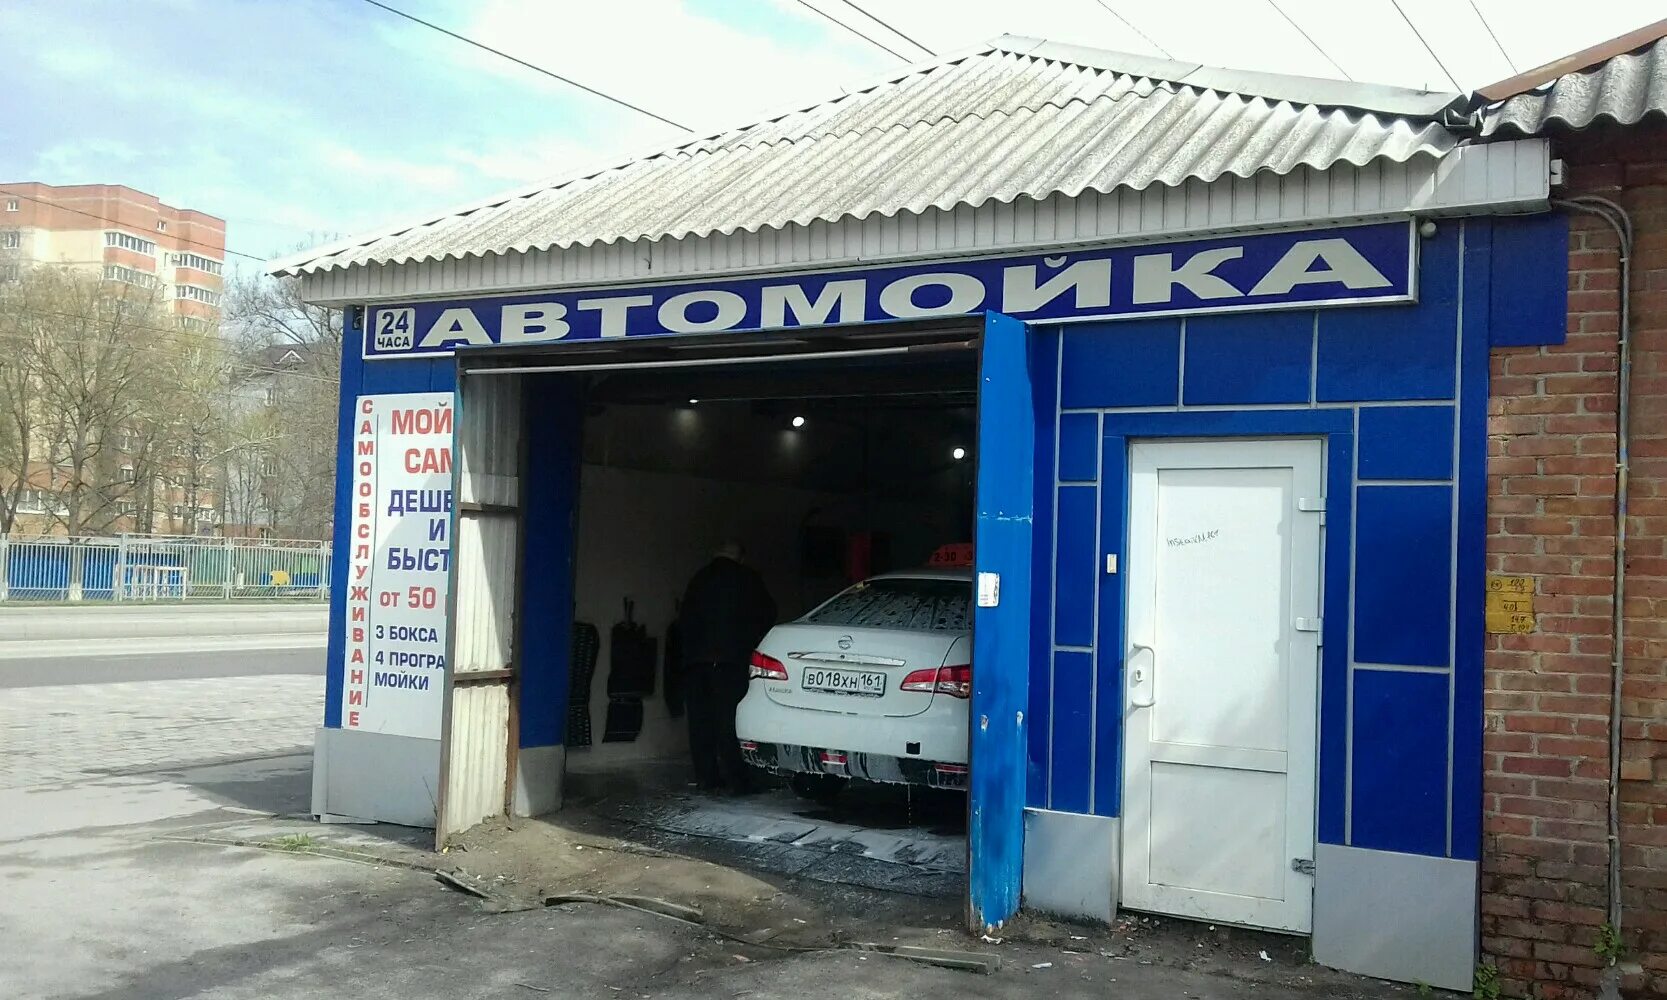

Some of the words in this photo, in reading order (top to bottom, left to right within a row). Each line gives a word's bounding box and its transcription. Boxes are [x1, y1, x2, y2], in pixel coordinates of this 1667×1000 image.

[418, 238, 1394, 348] АВТОМОЙКА
[380, 311, 410, 335] 24
[377, 336, 411, 349] ЧАСА
[429, 518, 446, 541] И
[349, 399, 374, 727] САМООБСЛУЖИВАНИЕ
[387, 547, 450, 571] БЫСТ
[408, 586, 437, 609] 50
[375, 624, 385, 640] 3
[389, 625, 438, 643] БОКСА
[375, 651, 384, 665] 4
[389, 651, 446, 670] ПРОГРА
[374, 670, 429, 691] МОЙКИ
